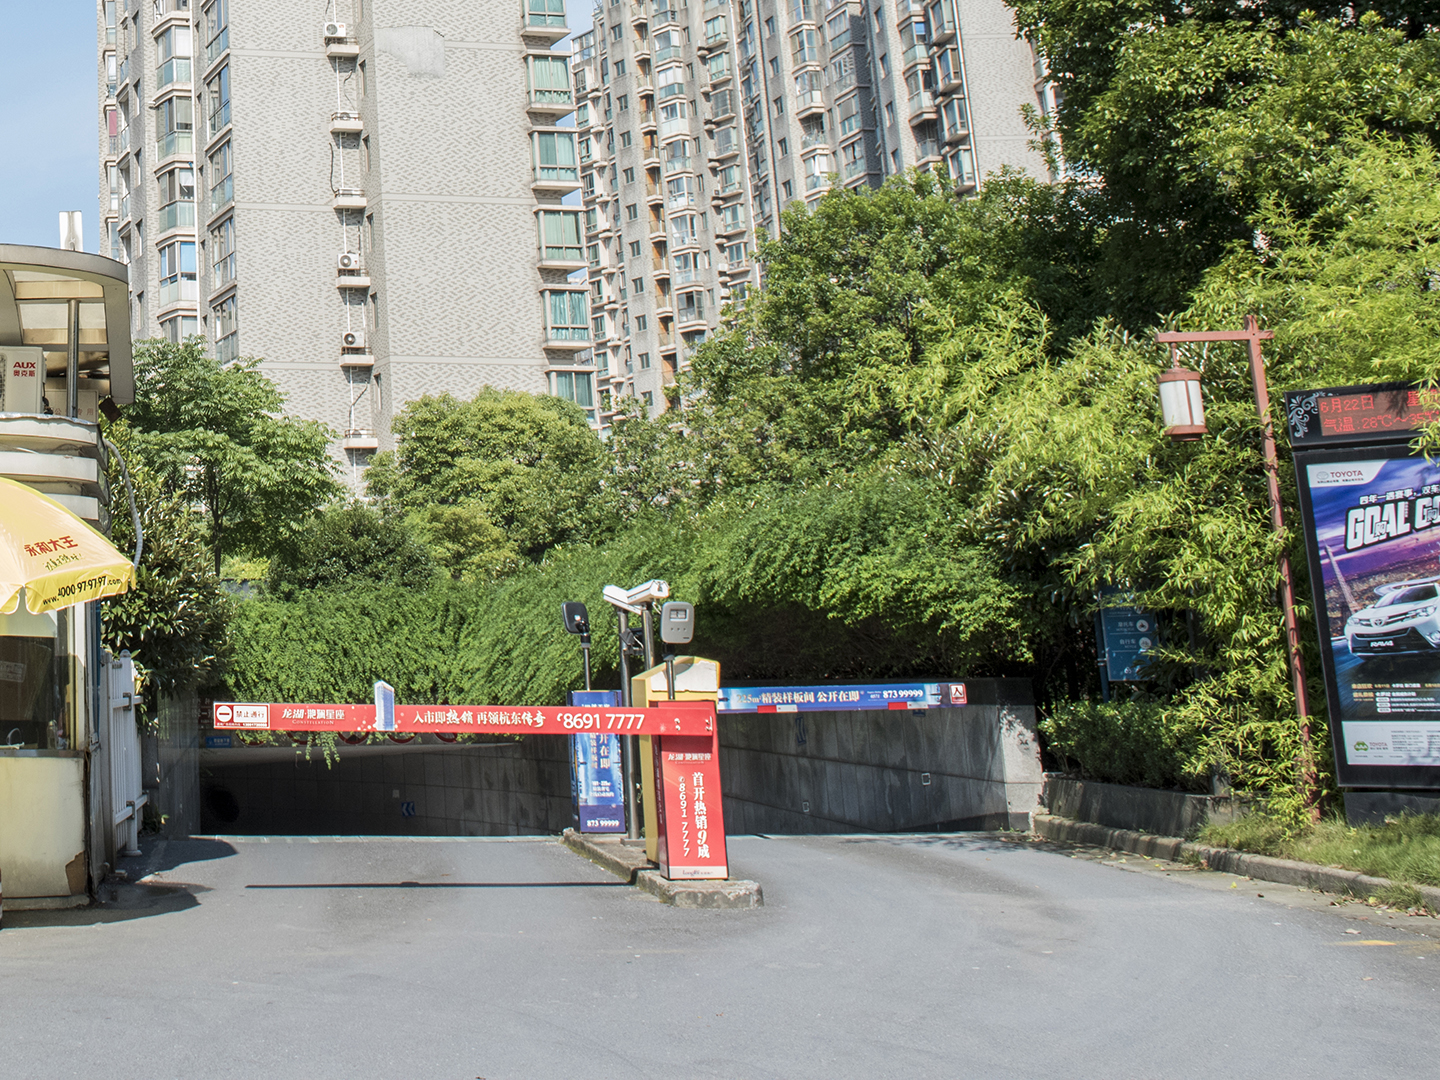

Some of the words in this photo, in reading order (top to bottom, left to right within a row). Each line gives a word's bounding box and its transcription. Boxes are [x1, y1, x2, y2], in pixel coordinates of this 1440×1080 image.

[1320, 394, 1375, 414] 6月22日
[1330, 470, 1363, 478] TOYOTA
[1346, 501, 1411, 550] GOAL
[24, 535, 79, 557] 永和大王
[1370, 640, 1394, 648] RAV4
[882, 689, 898, 699] 873
[898, 689, 924, 698] 99999
[235, 710, 265, 719] 禁止通行
[563, 713, 601, 730] 8691
[606, 713, 645, 730] 7777
[691, 771, 711, 859] 首开热销9成
